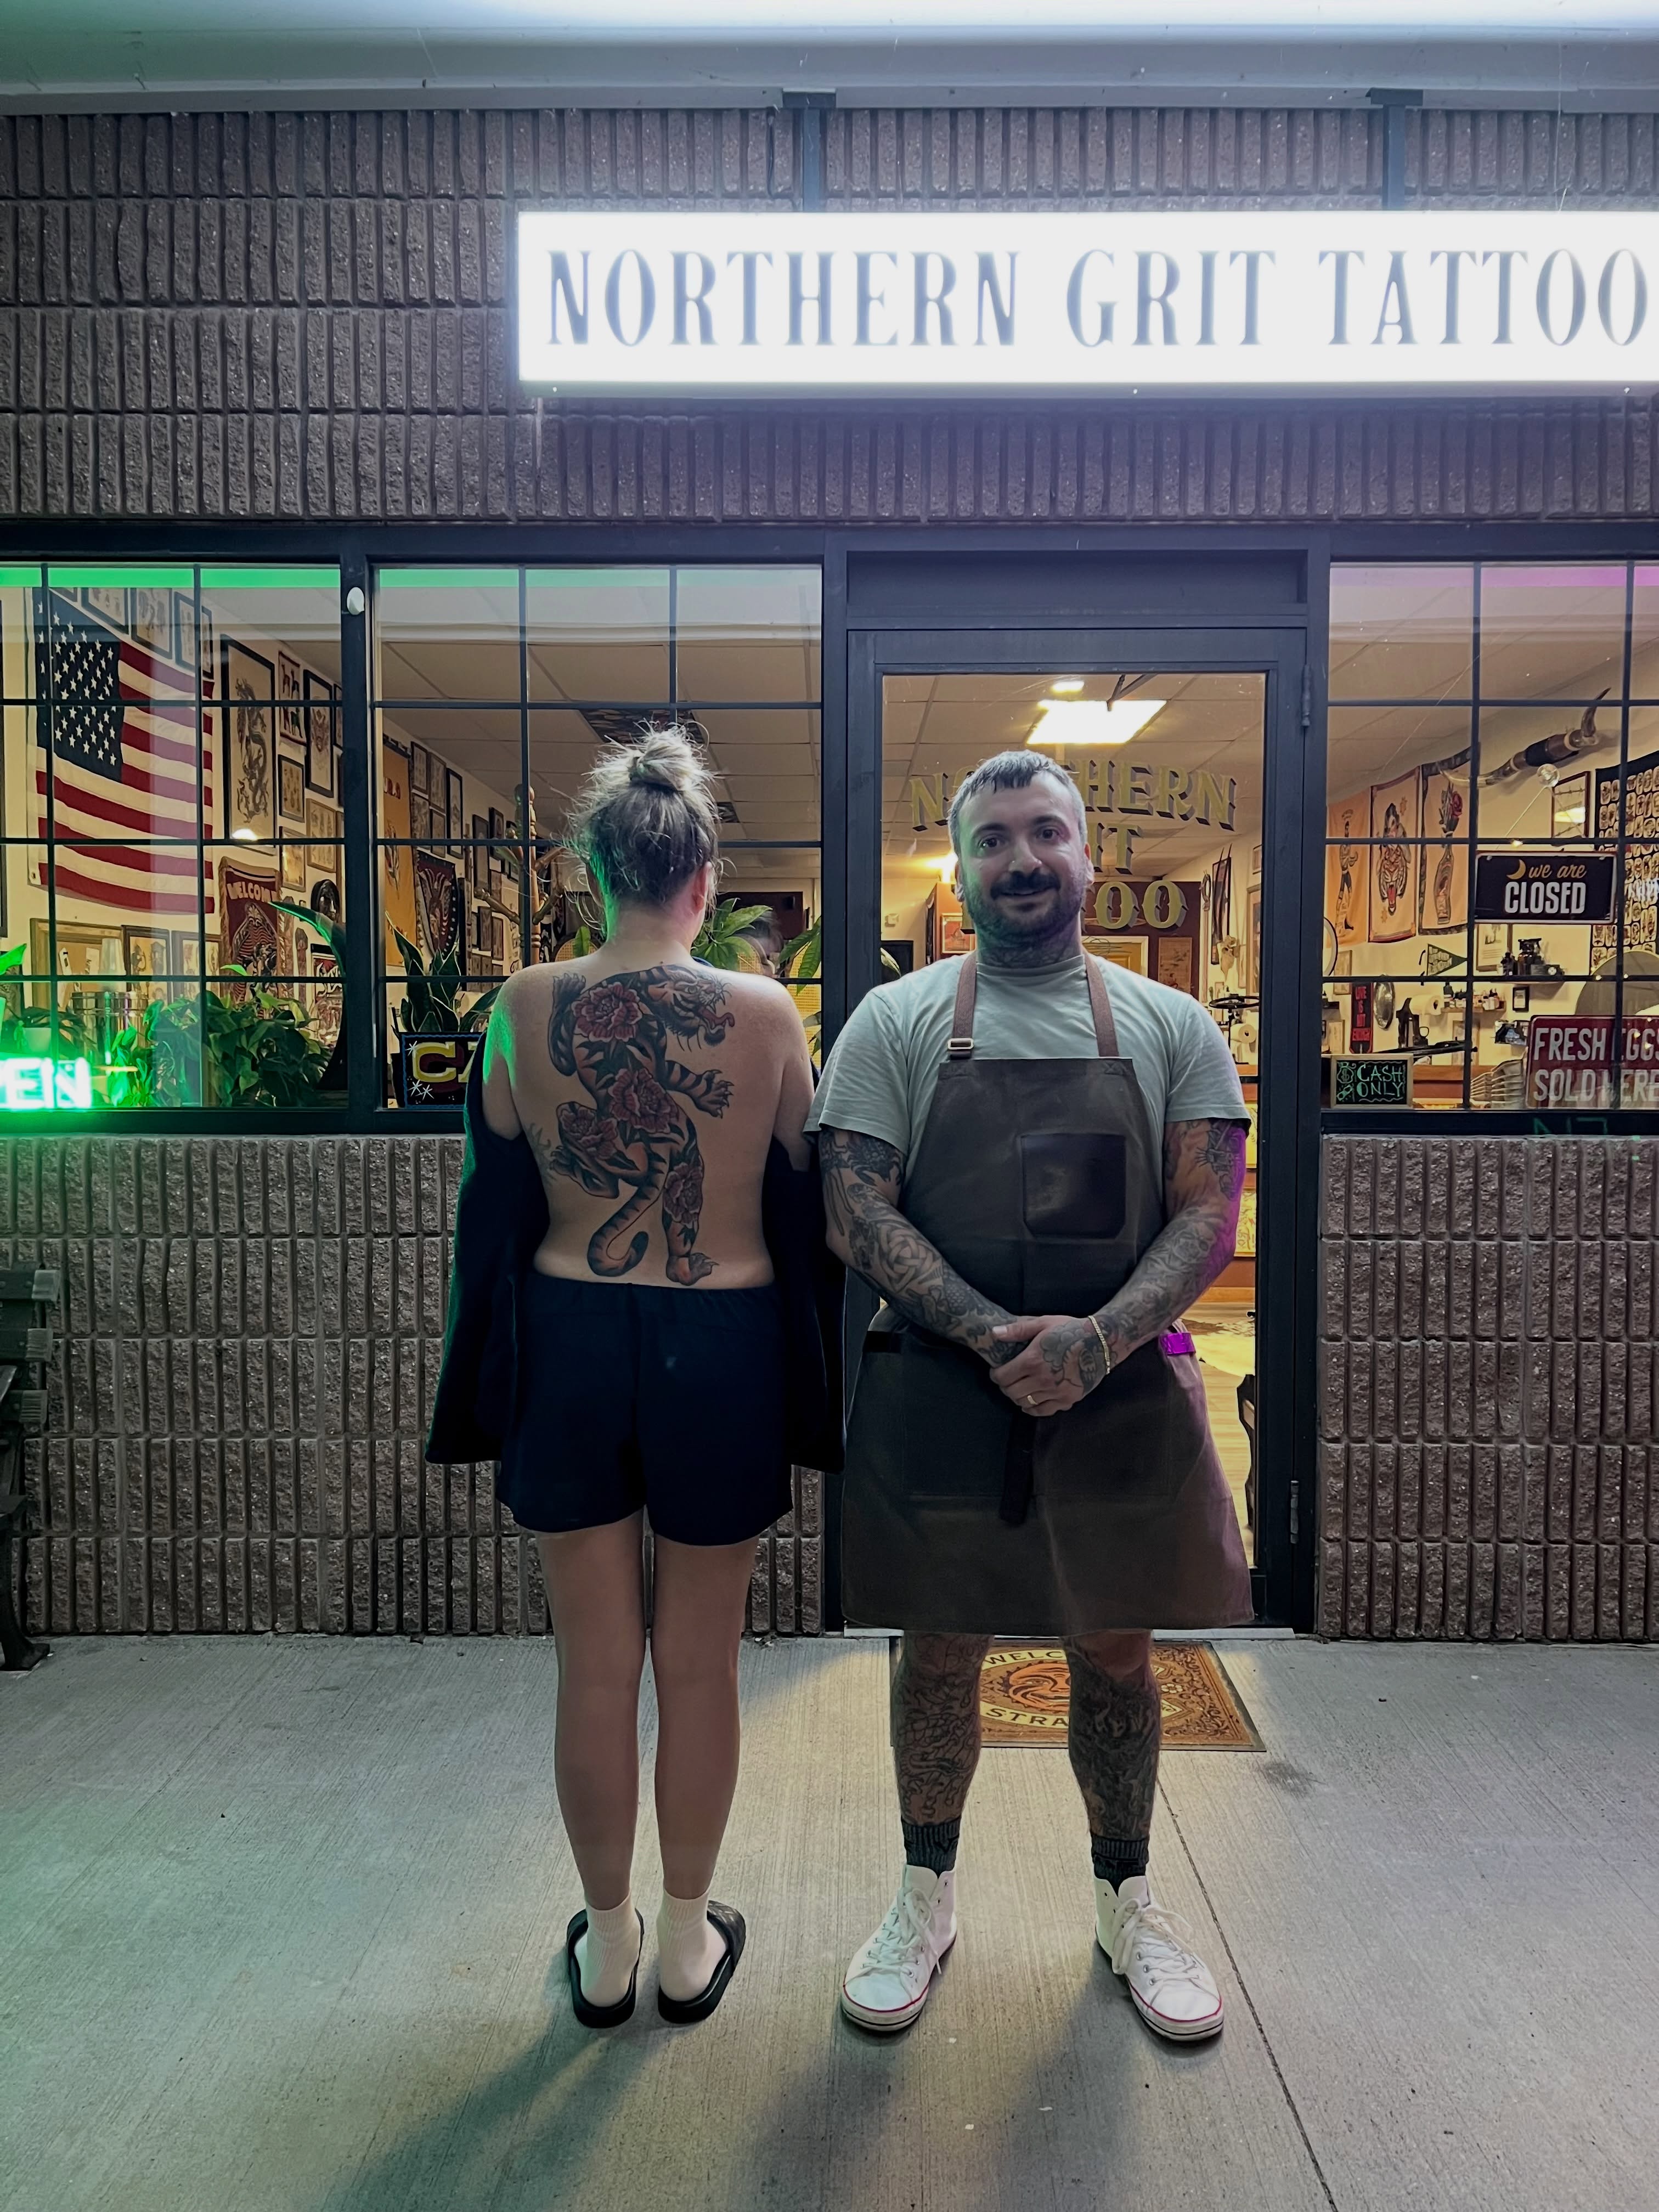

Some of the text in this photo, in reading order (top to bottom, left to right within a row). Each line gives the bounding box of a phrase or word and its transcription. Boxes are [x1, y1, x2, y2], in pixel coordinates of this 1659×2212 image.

[548, 249, 1647, 347] NORTHERN GRIT TATTOO
[909, 760, 1236, 832] NHERN
[1528, 865, 1587, 878] we are
[1504, 881, 1586, 913] CLOSED
[1534, 1028, 1607, 1060] FRESH
[1356, 1081, 1404, 1097] ONLY
[1357, 1064, 1403, 1082] CASH
[1533, 1069, 1596, 1102] SOLD
[985, 1651, 1063, 1665] WELC
